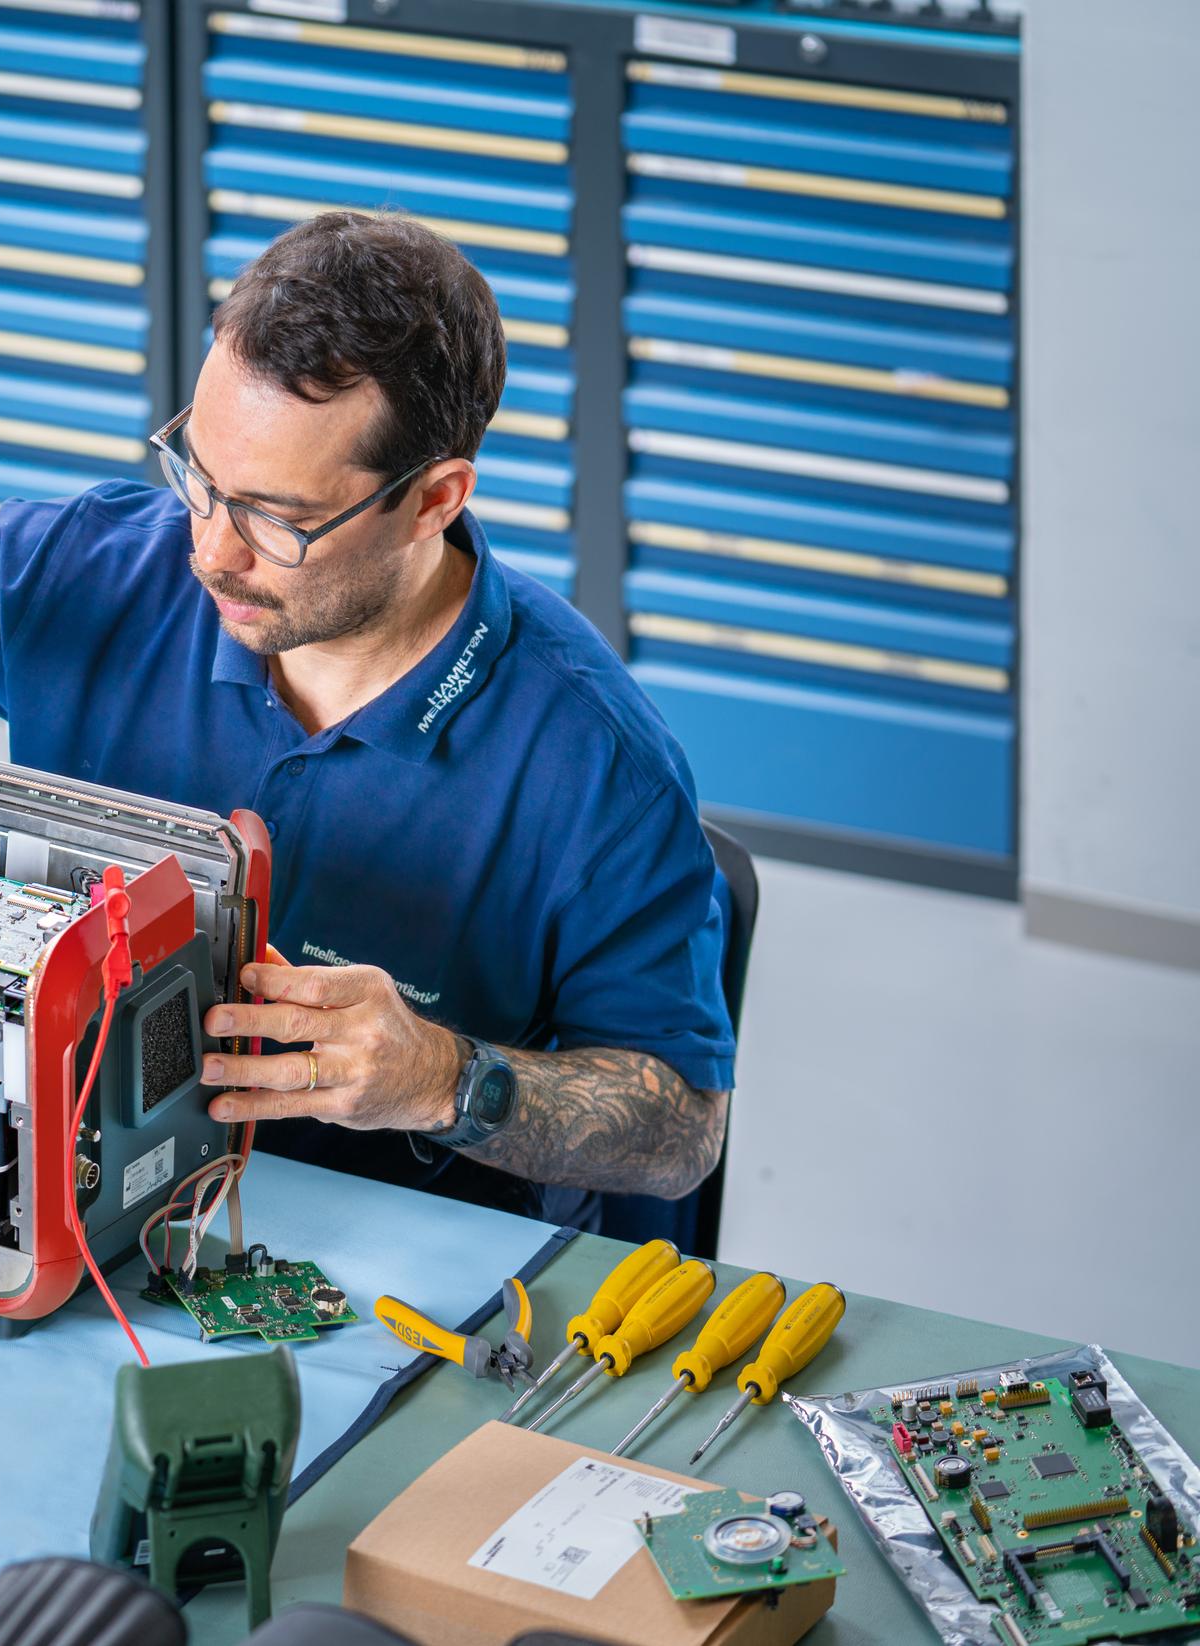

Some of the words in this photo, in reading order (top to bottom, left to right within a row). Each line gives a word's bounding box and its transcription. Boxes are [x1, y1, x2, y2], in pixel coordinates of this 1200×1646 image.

[427, 622, 489, 705] HAMILTON
[417, 668, 476, 734] MEDICAL
[392, 979, 440, 1003] ntilation
[397, 1321, 421, 1345] ESD
